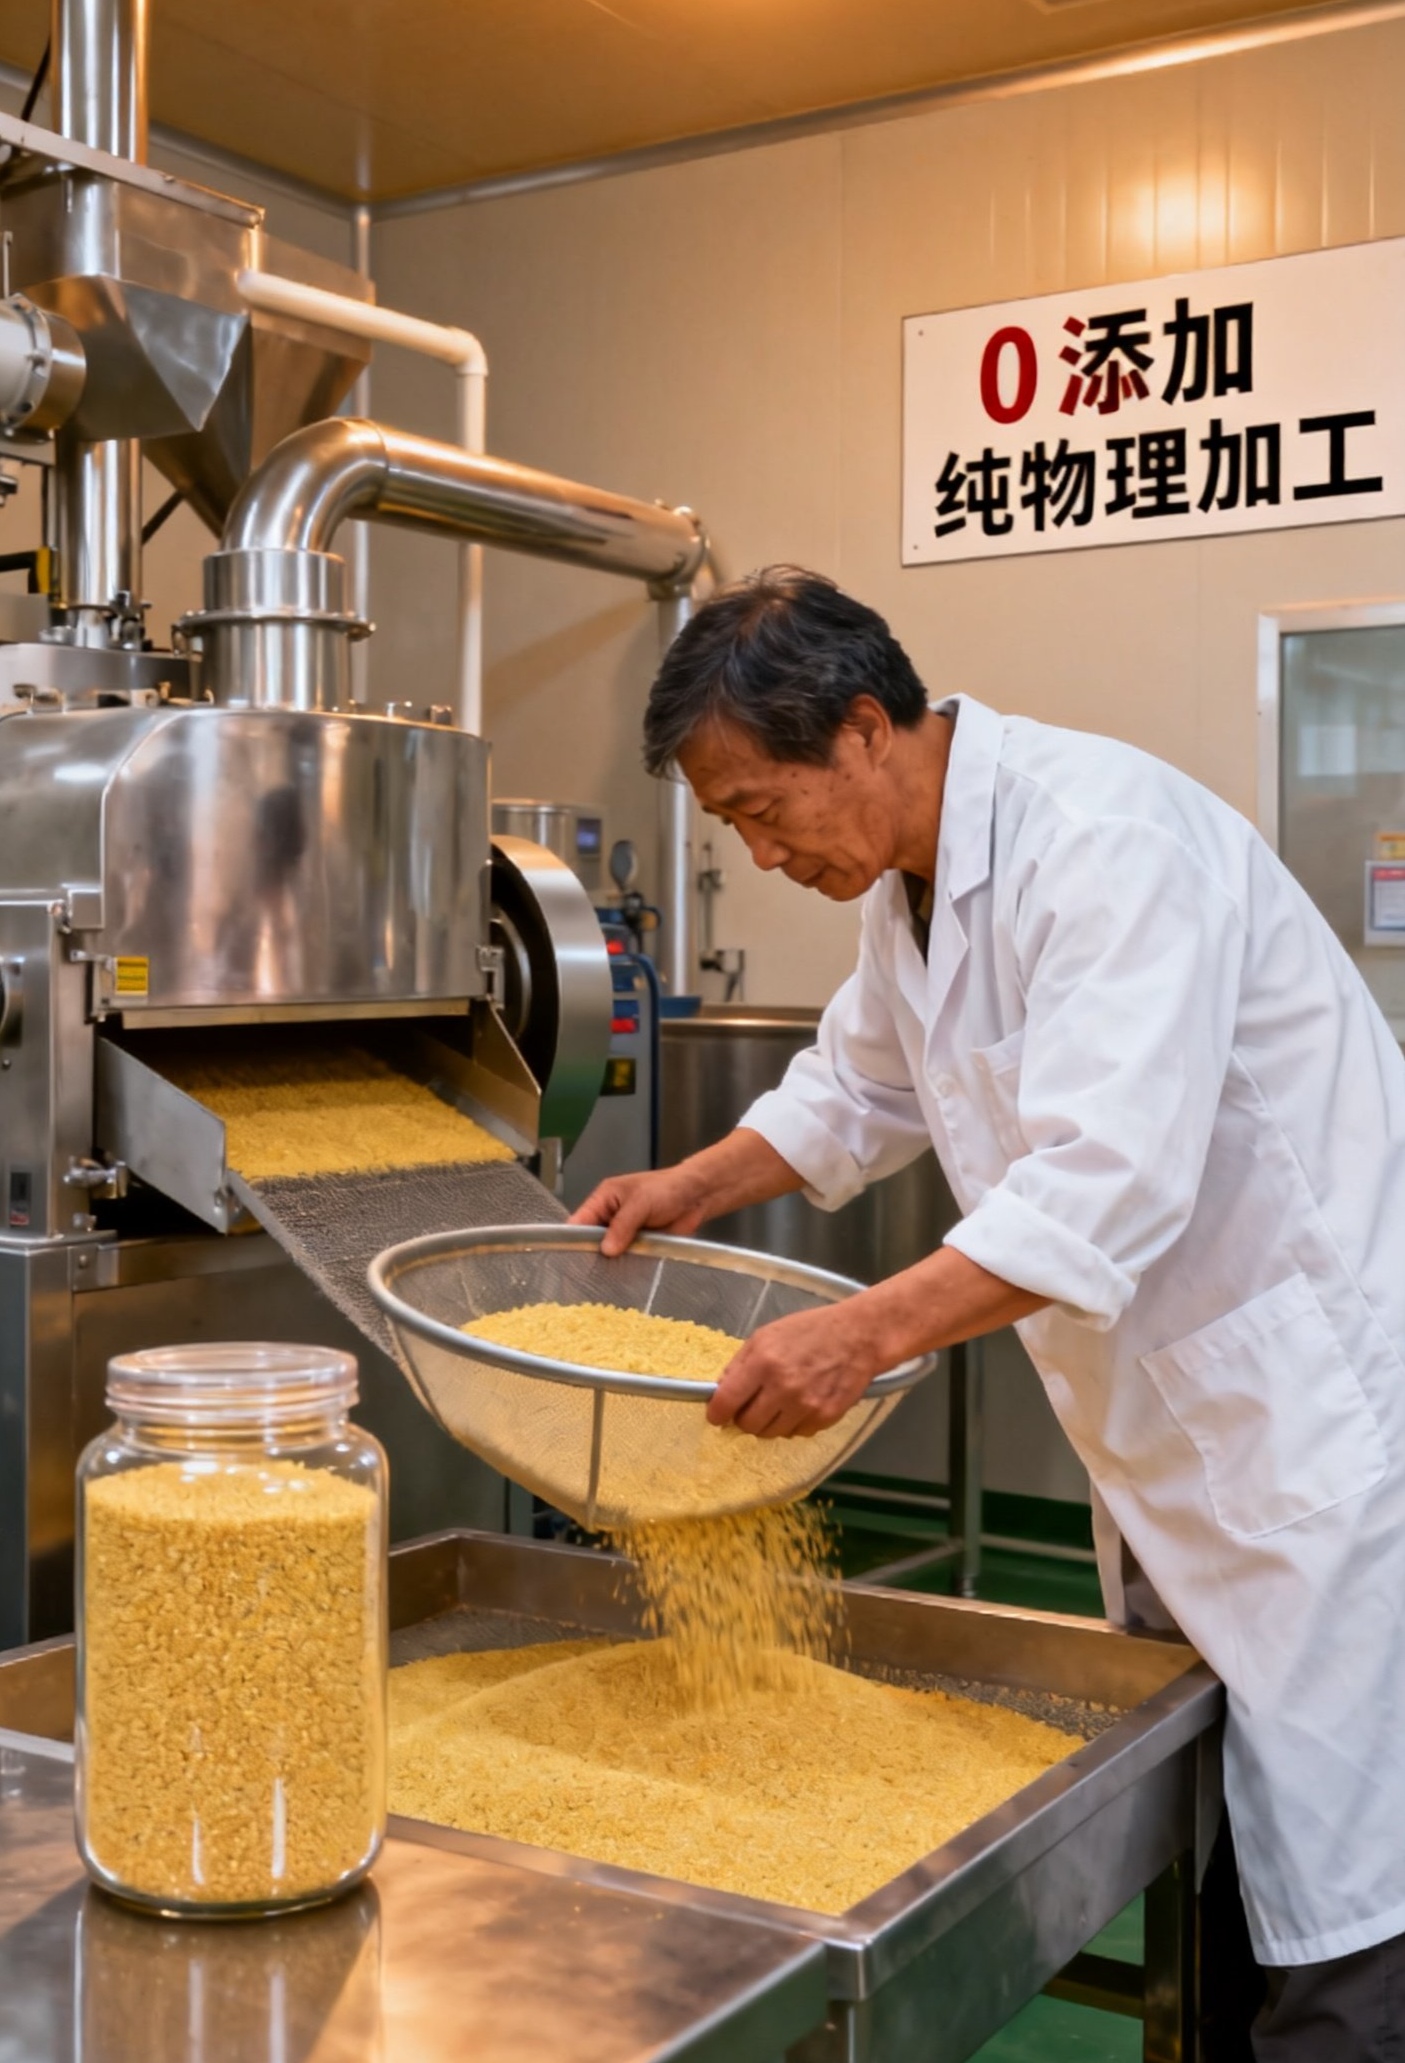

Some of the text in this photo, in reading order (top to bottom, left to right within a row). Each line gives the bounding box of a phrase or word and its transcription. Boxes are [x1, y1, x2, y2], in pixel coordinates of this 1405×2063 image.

[980, 297, 1254, 424] 0 添加
[934, 410, 1384, 538] 纯物理加工
